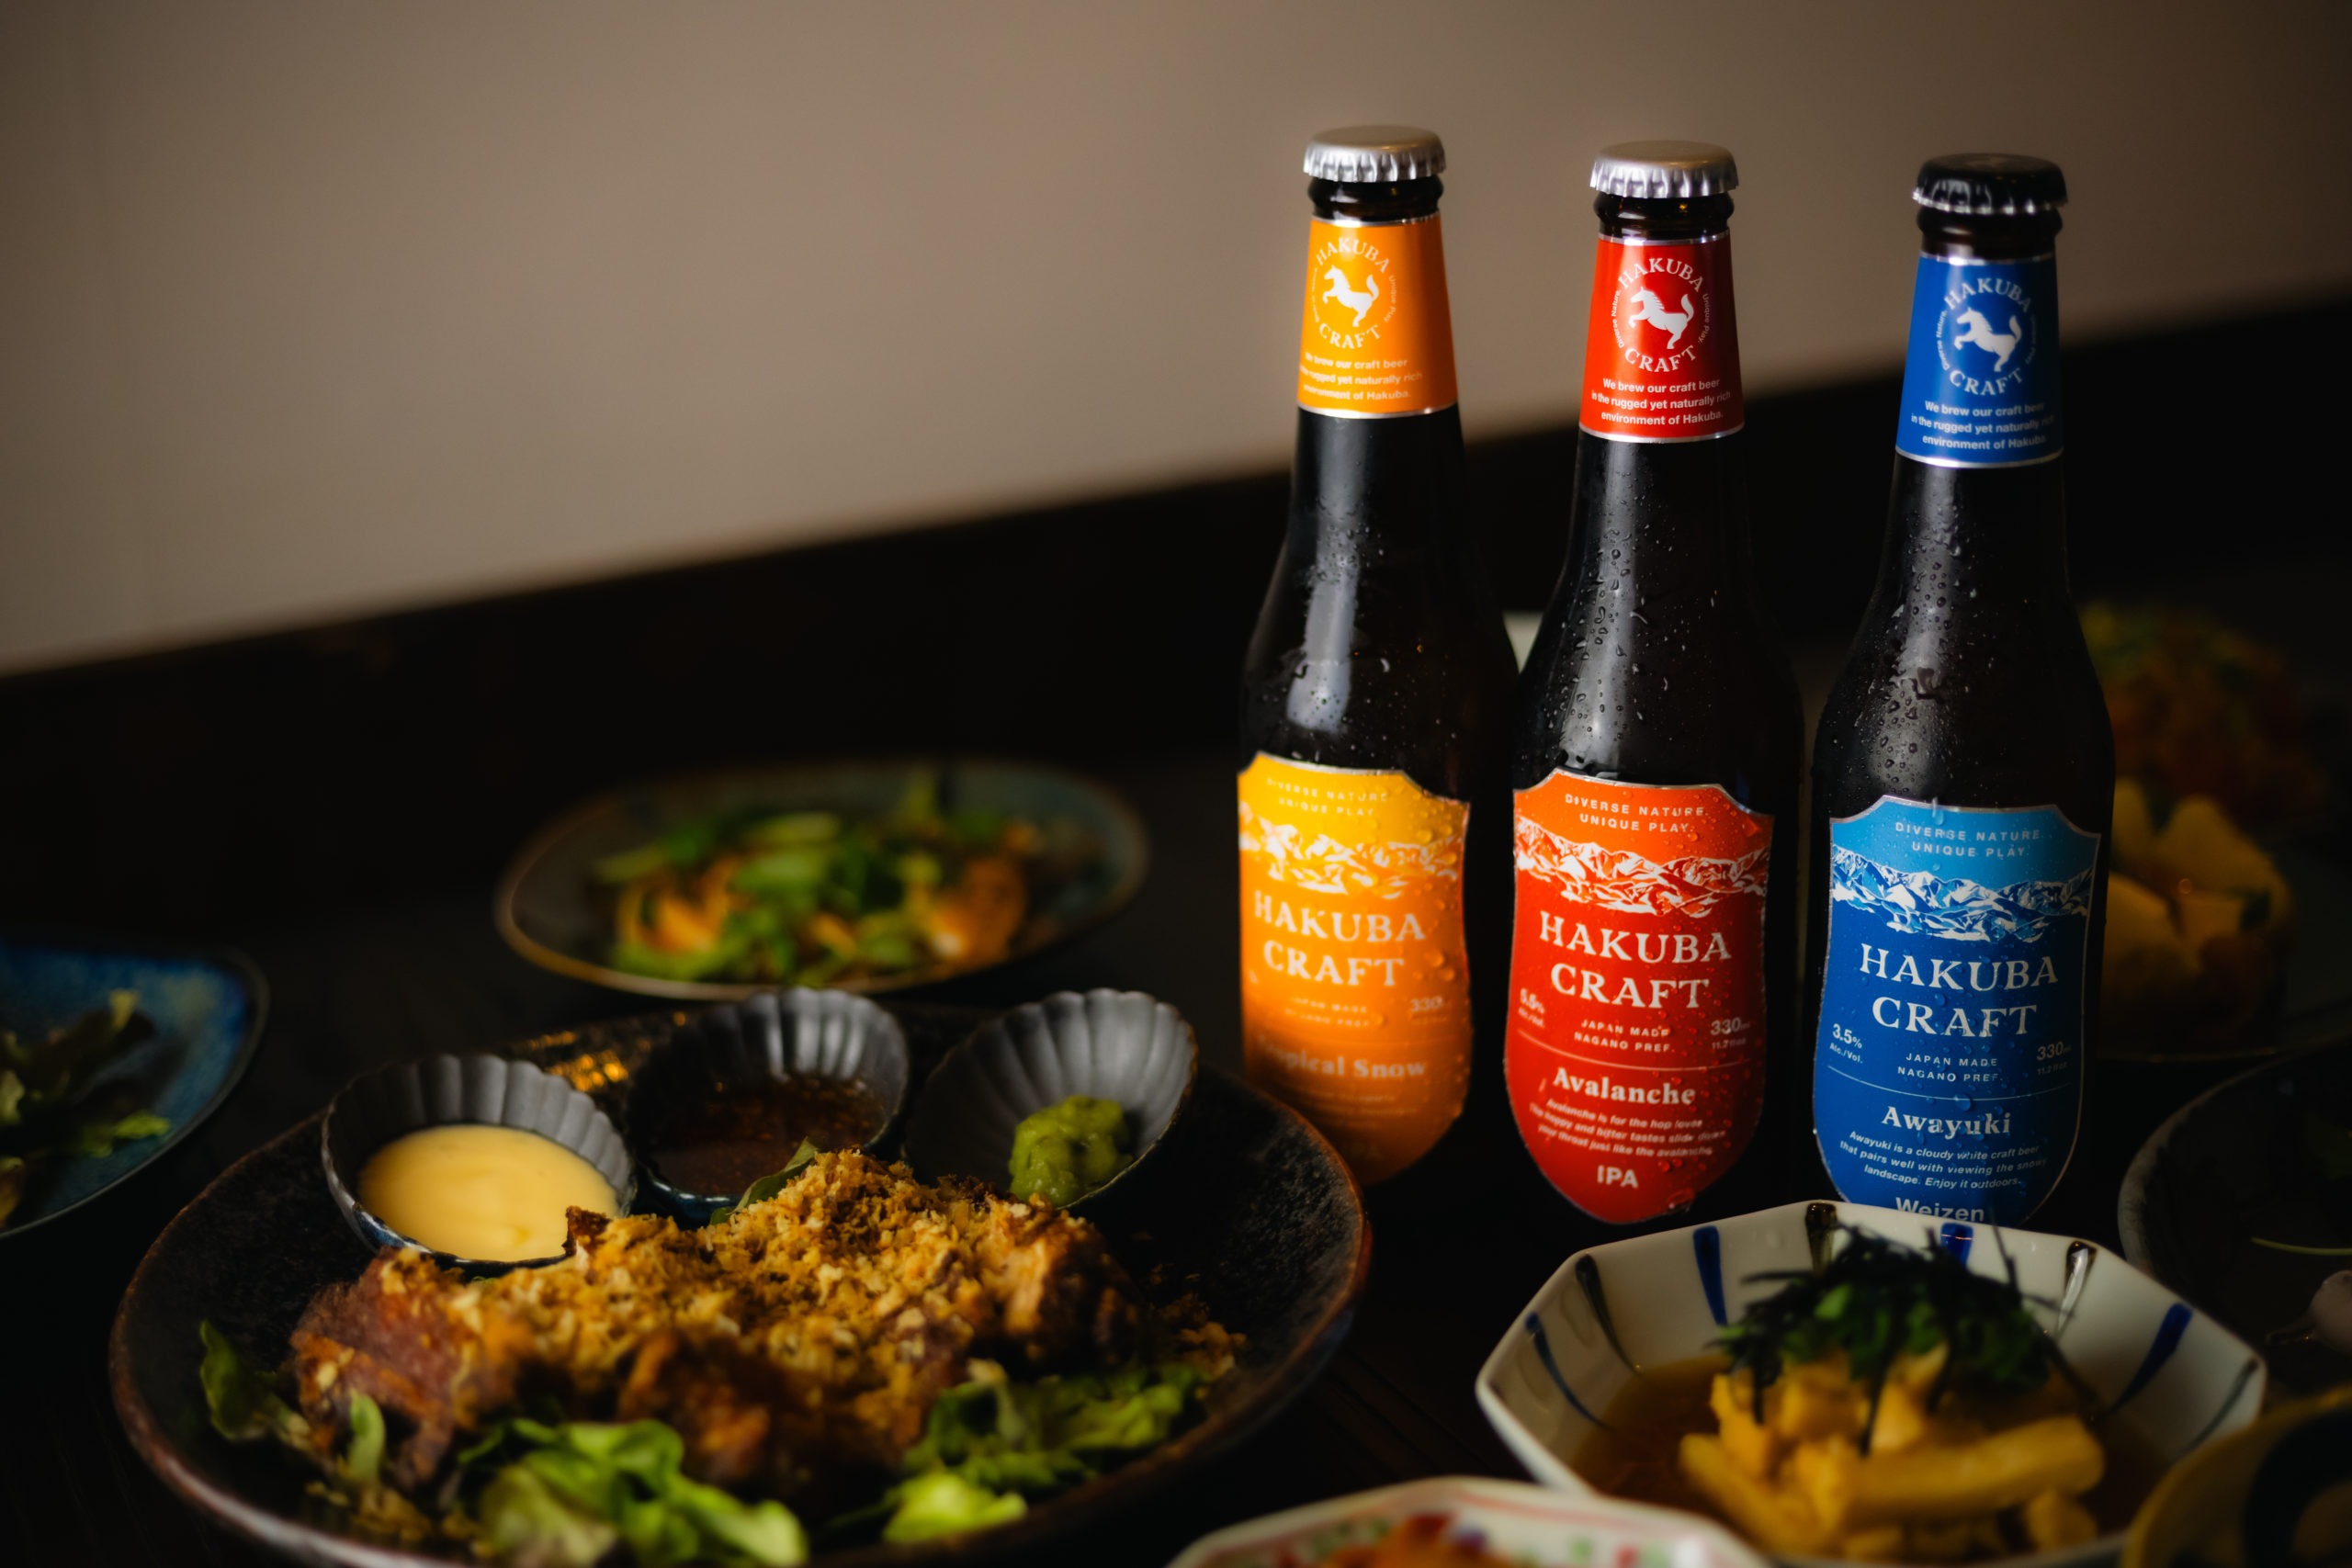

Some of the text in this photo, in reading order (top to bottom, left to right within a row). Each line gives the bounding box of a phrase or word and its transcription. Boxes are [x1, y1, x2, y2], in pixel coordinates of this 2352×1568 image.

[1317, 237, 1390, 274] HAKUBA
[1618, 257, 1704, 292] HAKUBA
[1943, 277, 2031, 313] HAKUBA
[1702, 293, 1712, 323] Unique
[1318, 322, 1381, 350] CRAFT
[1611, 318, 1625, 350] Diverse
[1335, 360, 1352, 369] our
[1353, 358, 1381, 369] craft
[1383, 359, 1408, 369] beer
[1624, 344, 1697, 373] CRAFT
[1337, 375, 1353, 386] yet
[1354, 372, 1401, 385] naturally
[1403, 370, 1423, 382] rich
[1602, 378, 1720, 393] We brew our craft beer
[1950, 367, 2023, 396] CRAFT
[1352, 390, 1364, 400] of
[1598, 392, 1610, 405] the
[1611, 397, 1647, 411] rugged
[1649, 399, 1668, 412] yet
[1669, 396, 1715, 410] naturally
[1715, 390, 1731, 403] rich
[1600, 412, 1666, 425] environment
[1668, 414, 1680, 425] of
[1925, 400, 1939, 412] We
[1940, 404, 1970, 417] brew
[1972, 408, 1993, 417] our
[1995, 405, 2022, 417] craft
[1911, 412, 1918, 423] in
[1918, 415, 1932, 428] the
[1933, 420, 1973, 434] rugged
[1974, 423, 1993, 435] yet
[1995, 419, 2040, 433] naturally
[1922, 434, 1991, 449] environment
[1993, 439, 2007, 449] of
[1267, 777, 1318, 798] DIVERSE
[1278, 796, 1329, 815] UNIQUE
[1565, 793, 1630, 815] DIVERSE
[1580, 813, 1640, 832] UNIQUE
[1894, 821, 1967, 841] DIVERSE
[1911, 840, 1976, 857] UNIQUE
[1254, 889, 1426, 943] HAKUBA
[1539, 910, 1733, 964] HAKUBA
[1263, 939, 1405, 987] CRAFT
[1860, 942, 2059, 992] HAKUBA
[1550, 963, 1710, 1010] CRAFT
[1580, 1018, 1624, 1034] JAPAN
[1871, 996, 2038, 1037] CRAFT
[1574, 1031, 1629, 1050] NAGANO
[1832, 1022, 1862, 1049] 3.5%
[1352, 1058, 1426, 1079] Snow
[1905, 1053, 1998, 1067] JAPAN MADE
[1553, 1066, 1696, 1106] Avalanche
[1897, 1066, 2004, 1082] NAGANO PREF.
[1546, 1099, 1597, 1121] Avalanche
[1598, 1112, 1608, 1122] is
[1610, 1115, 1626, 1126] for
[1629, 1118, 1647, 1128] the
[1649, 1118, 1673, 1130] hop
[1881, 1105, 2012, 1140] Awayuki
[1544, 1111, 1573, 1130] hoppy
[1575, 1122, 1595, 1134] and
[1630, 1132, 1666, 1144] tastes
[1668, 1133, 1695, 1144] slide
[1558, 1131, 1589, 1147] throat
[1589, 1139, 1611, 1152] just
[1612, 1143, 1633, 1156] like
[1635, 1145, 1655, 1156] the
[1849, 1131, 2041, 1161] Awayuki is a cloudy white craft beer
[1839, 1139, 2048, 1177] that pairs well with viewing the snowy
[1596, 1165, 1639, 1189] IPA
[1925, 1177, 1958, 1190] Enjoy
[1959, 1178, 1969, 1189] it
[1970, 1177, 2022, 1190] outdoors.
[1894, 1196, 1985, 1222] Weizen
